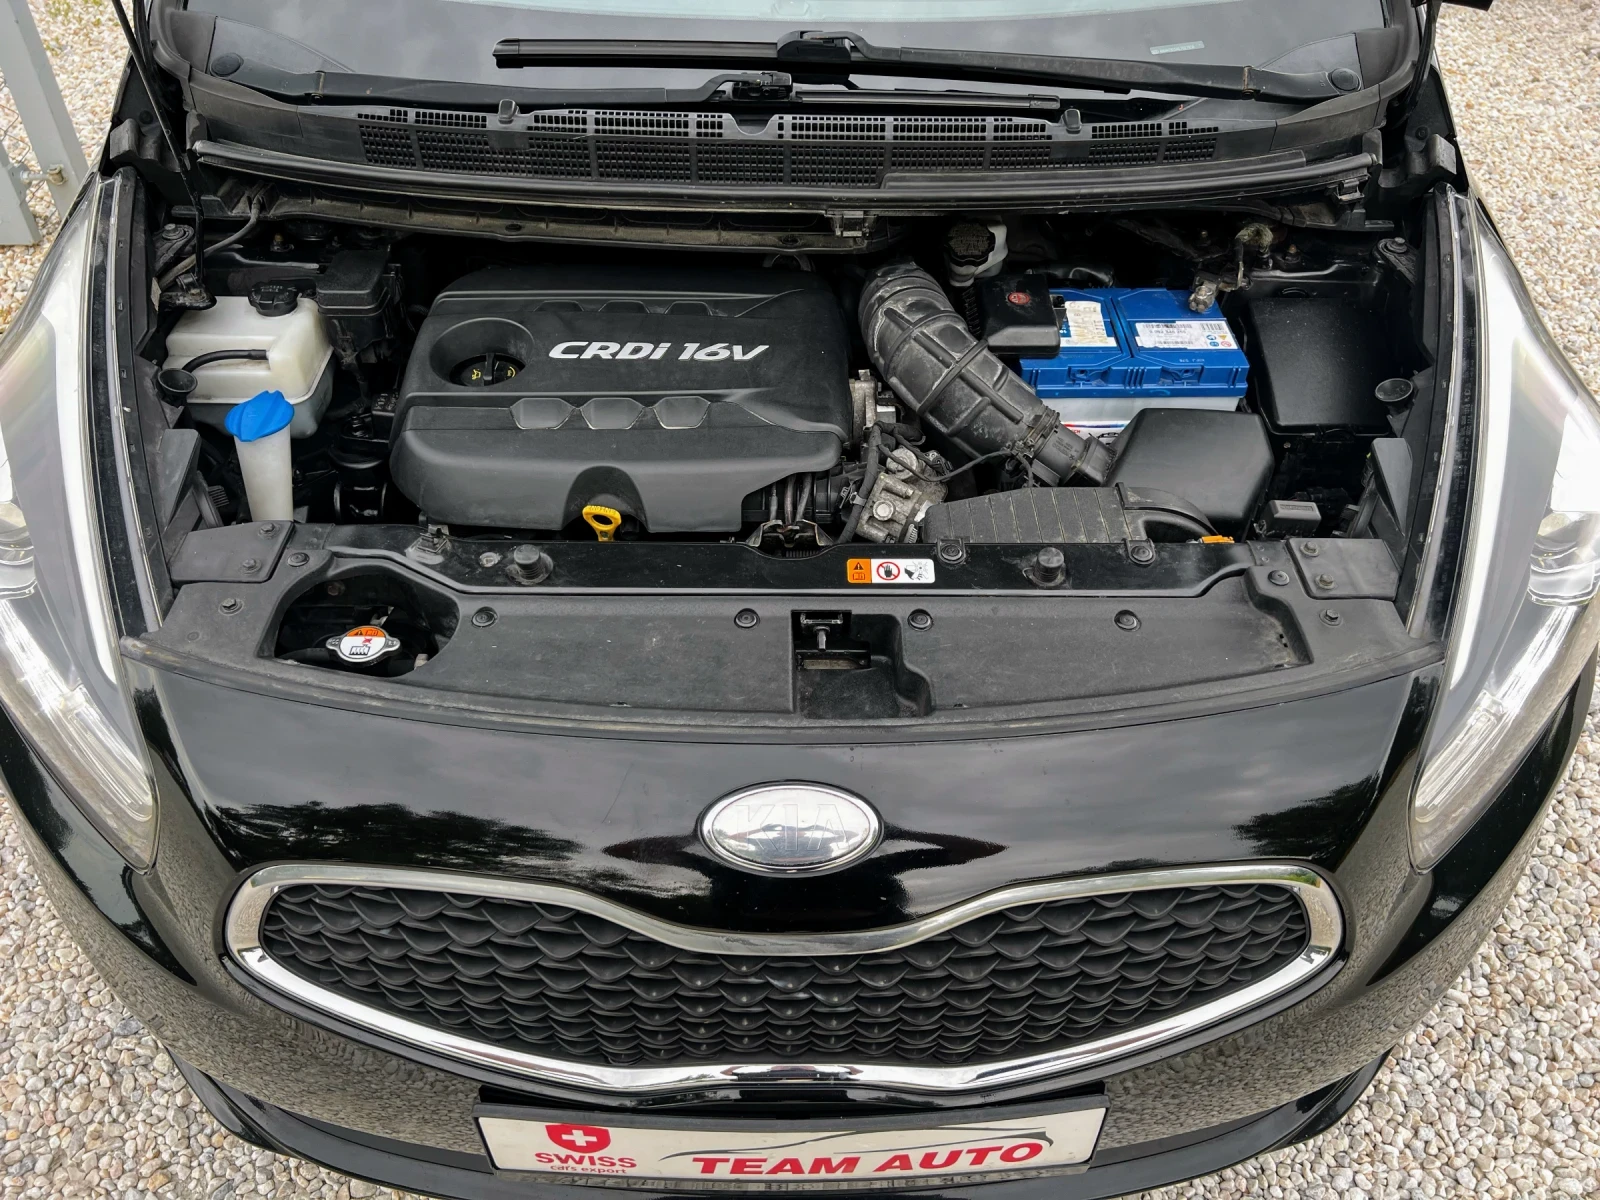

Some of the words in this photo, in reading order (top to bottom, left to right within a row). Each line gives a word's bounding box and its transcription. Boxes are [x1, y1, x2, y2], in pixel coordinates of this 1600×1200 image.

[549, 341, 671, 360] CRDi
[678, 342, 769, 361] 16V
[735, 804, 850, 850] KIA
[534, 1152, 637, 1168] SWISS
[692, 1156, 860, 1175] TEAM
[873, 1142, 1043, 1173] AUTO
